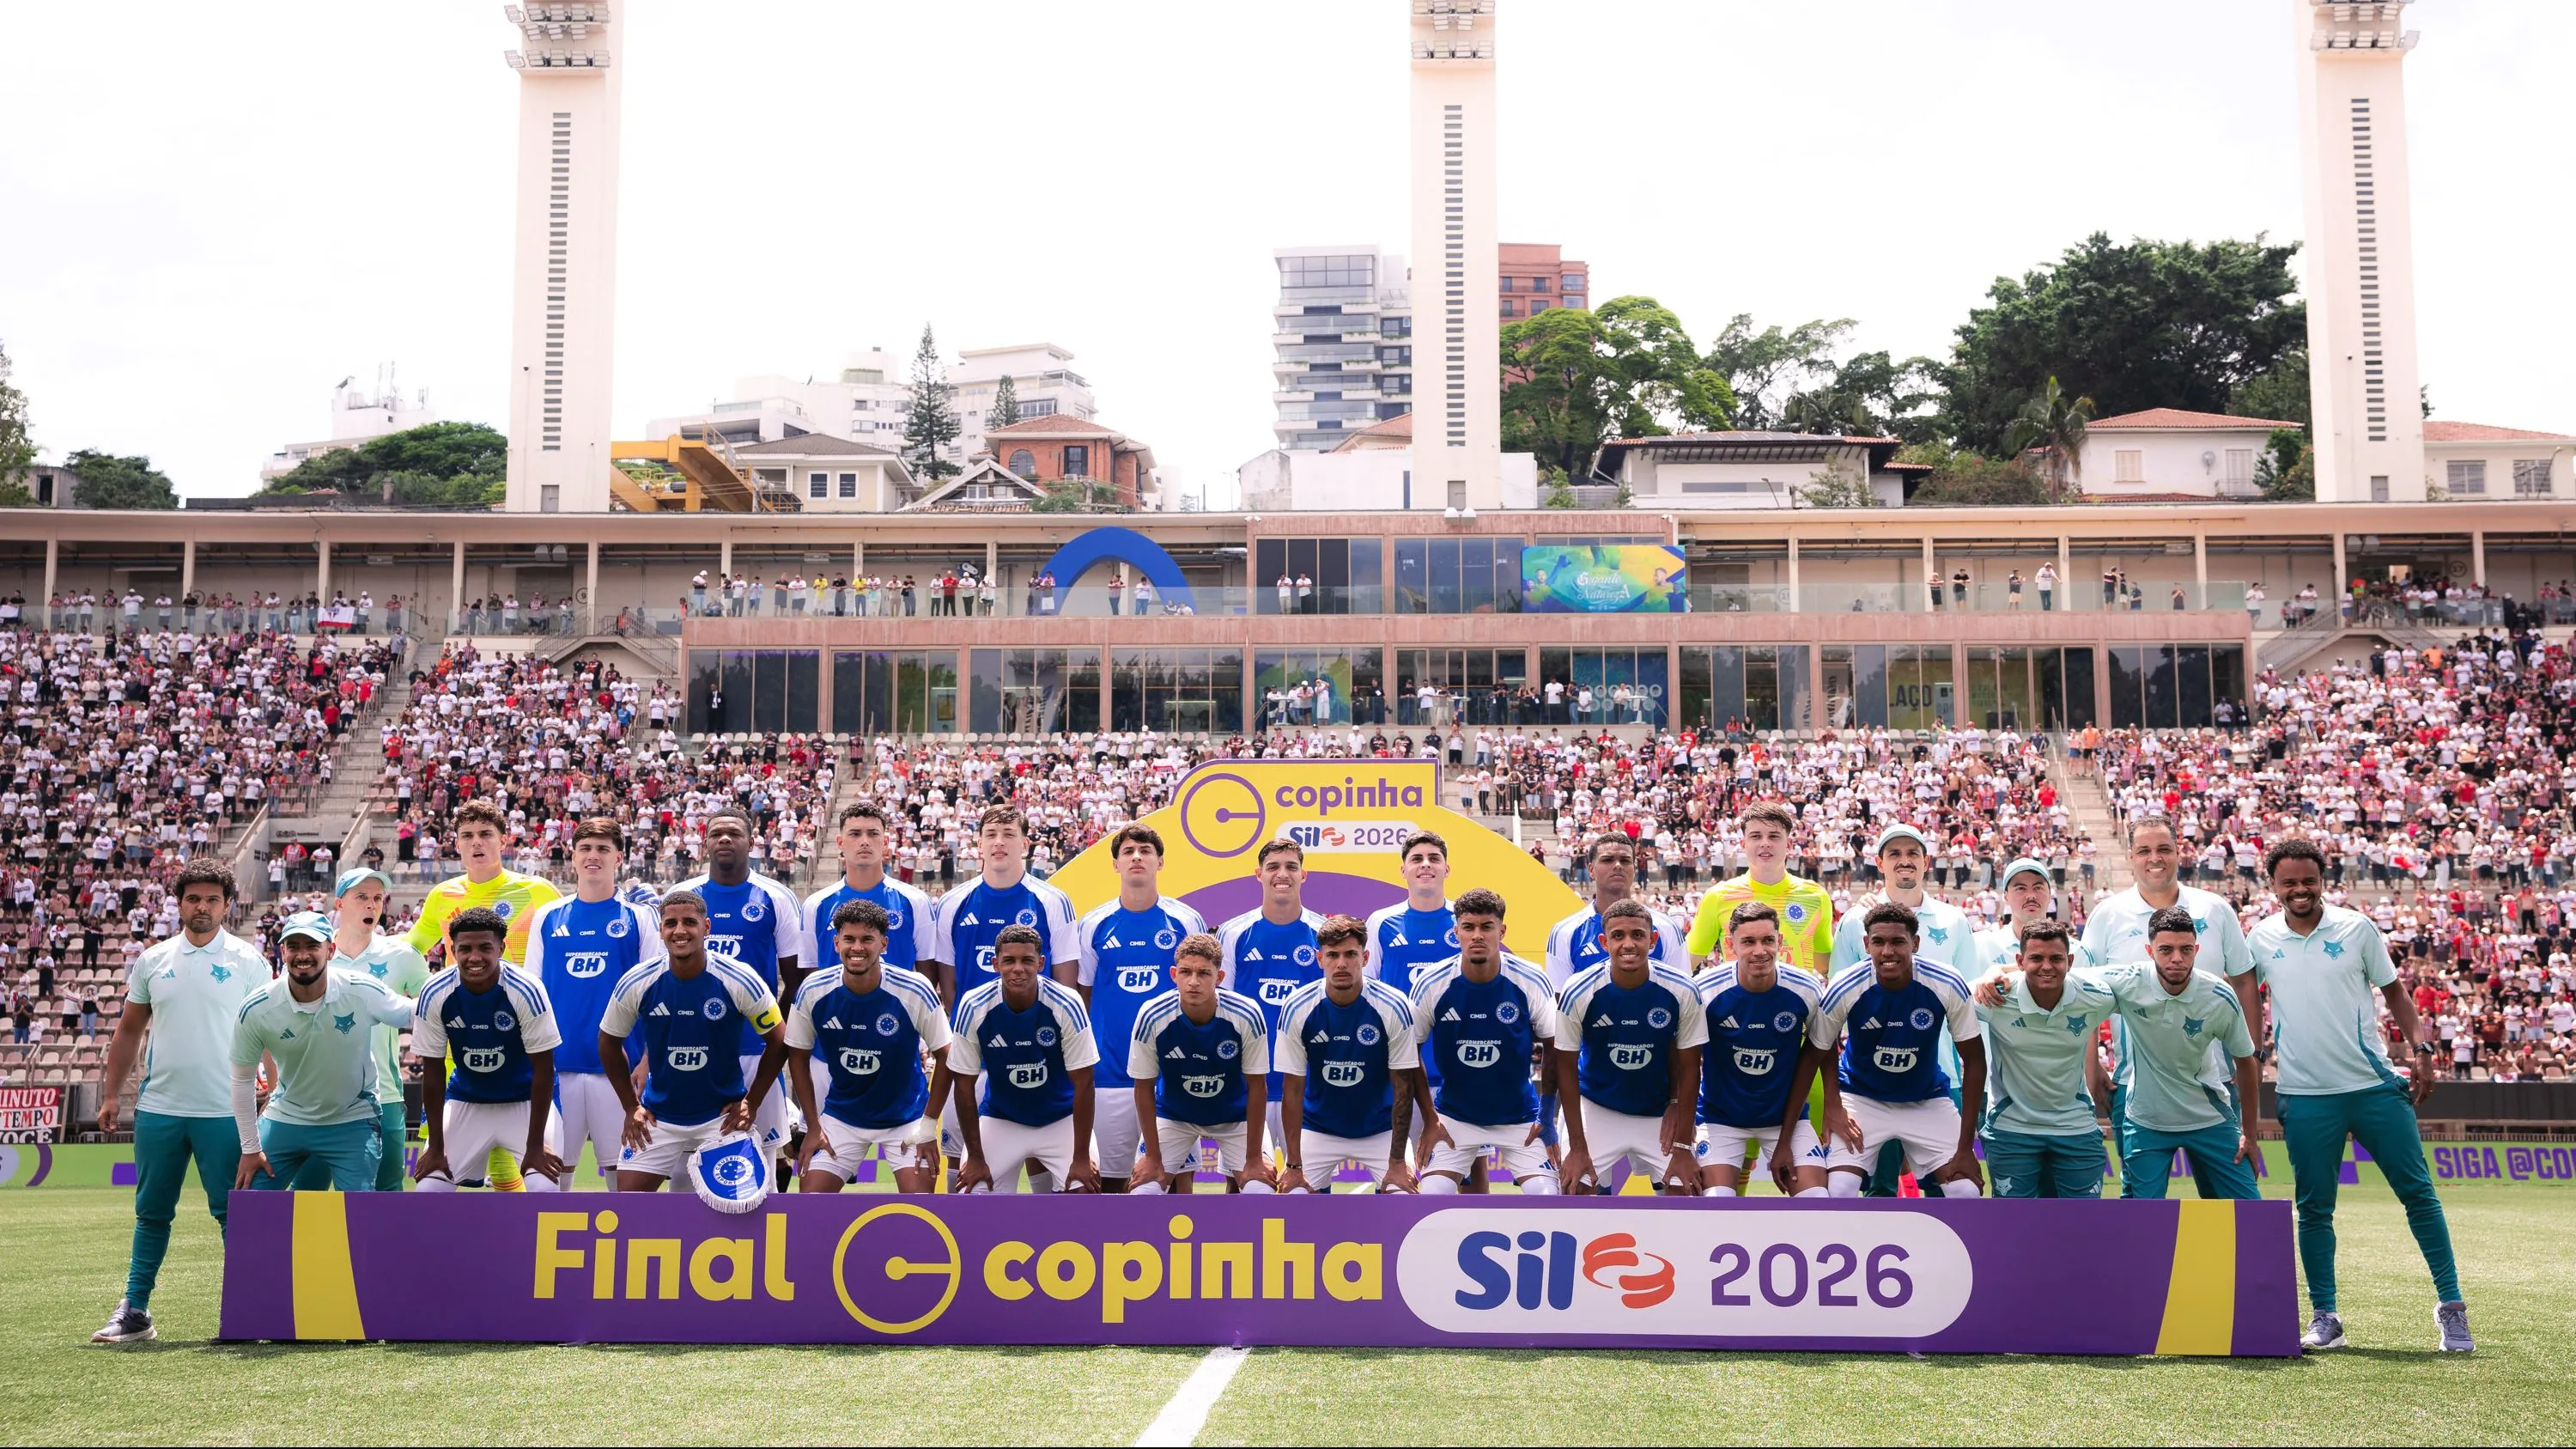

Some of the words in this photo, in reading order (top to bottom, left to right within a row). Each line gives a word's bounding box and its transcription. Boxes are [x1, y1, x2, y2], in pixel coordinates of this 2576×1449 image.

[1889, 684, 1932, 711] AÇO
[1275, 777, 1422, 815] copinha
[1290, 826, 1321, 847] Sil
[1354, 827, 1408, 846] 2026
[707, 940, 735, 955] BH
[572, 958, 601, 972] BH
[1124, 971, 1152, 987] BH
[1265, 983, 1293, 1000] BH
[756, 1010, 775, 1030] C
[838, 1046, 882, 1055] SUPERMERCADOS
[1464, 1045, 1494, 1062] BH
[1616, 1049, 1646, 1064] BH
[469, 1053, 499, 1068] BH
[674, 1052, 702, 1066] BH
[846, 1054, 874, 1069] BH
[1739, 1053, 1771, 1069] BH
[1879, 1052, 1911, 1068] BH
[1016, 1067, 1044, 1084] BH
[1327, 1066, 1358, 1081] BH
[1189, 1079, 1219, 1093] BH
[0, 1088, 57, 1107] INUTO
[3, 1109, 53, 1128] TEMPO
[2433, 1147, 2502, 1179] SIGA
[533, 1209, 794, 1301] Final
[984, 1215, 1382, 1324] copinha
[1455, 1231, 1577, 1311] Sil
[1710, 1243, 1913, 1308] 2026
